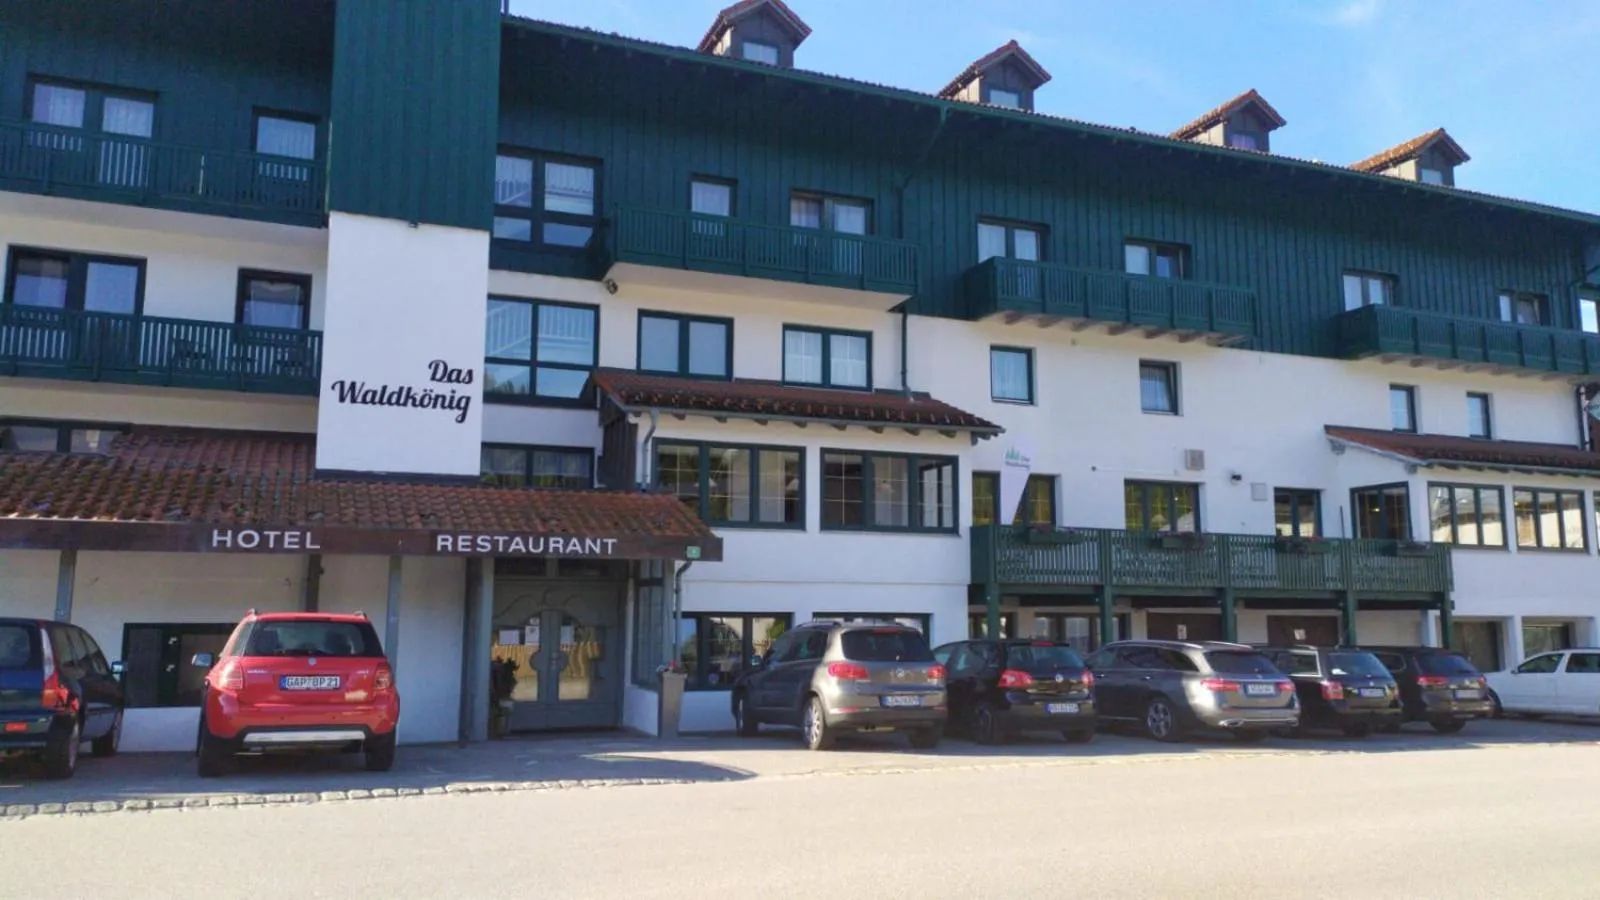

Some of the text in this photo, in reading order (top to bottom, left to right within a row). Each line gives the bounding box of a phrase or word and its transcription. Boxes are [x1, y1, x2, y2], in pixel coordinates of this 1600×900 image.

[428, 359, 474, 385] Das
[331, 380, 472, 424] Waldkönig
[212, 529, 321, 549] HOTEL
[436, 534, 618, 555] RESTAURANT
